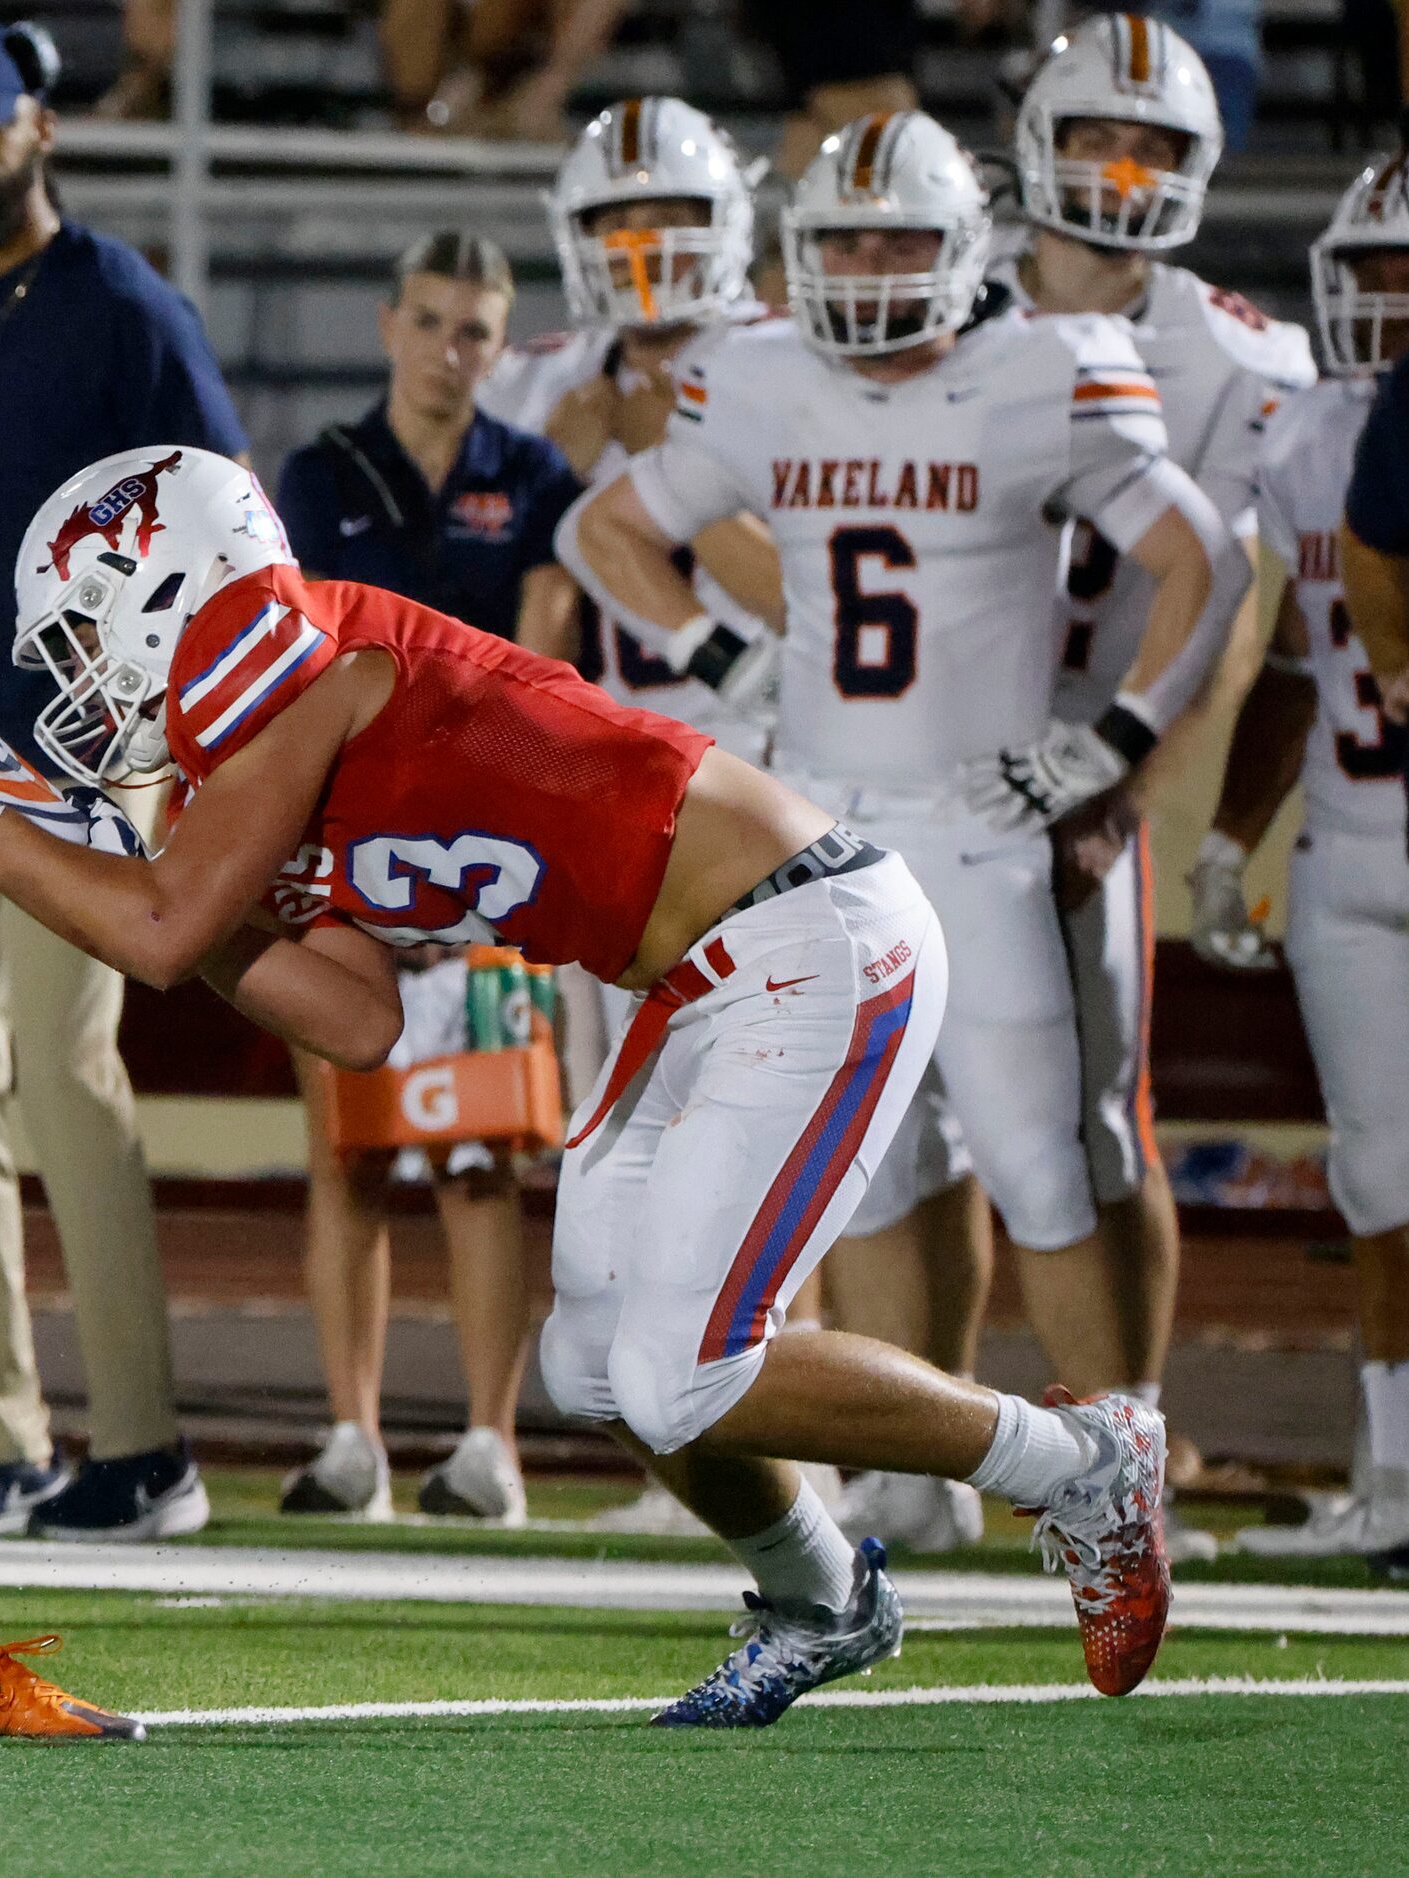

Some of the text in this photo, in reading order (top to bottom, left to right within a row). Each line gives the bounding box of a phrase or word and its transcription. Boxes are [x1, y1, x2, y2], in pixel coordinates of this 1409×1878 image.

[88, 476, 148, 528] GHS
[770, 457, 980, 514] WAKELAND
[827, 521, 918, 701] 6
[347, 829, 547, 946] 3
[861, 938, 913, 985] STANGS
[400, 1066, 460, 1132] G
